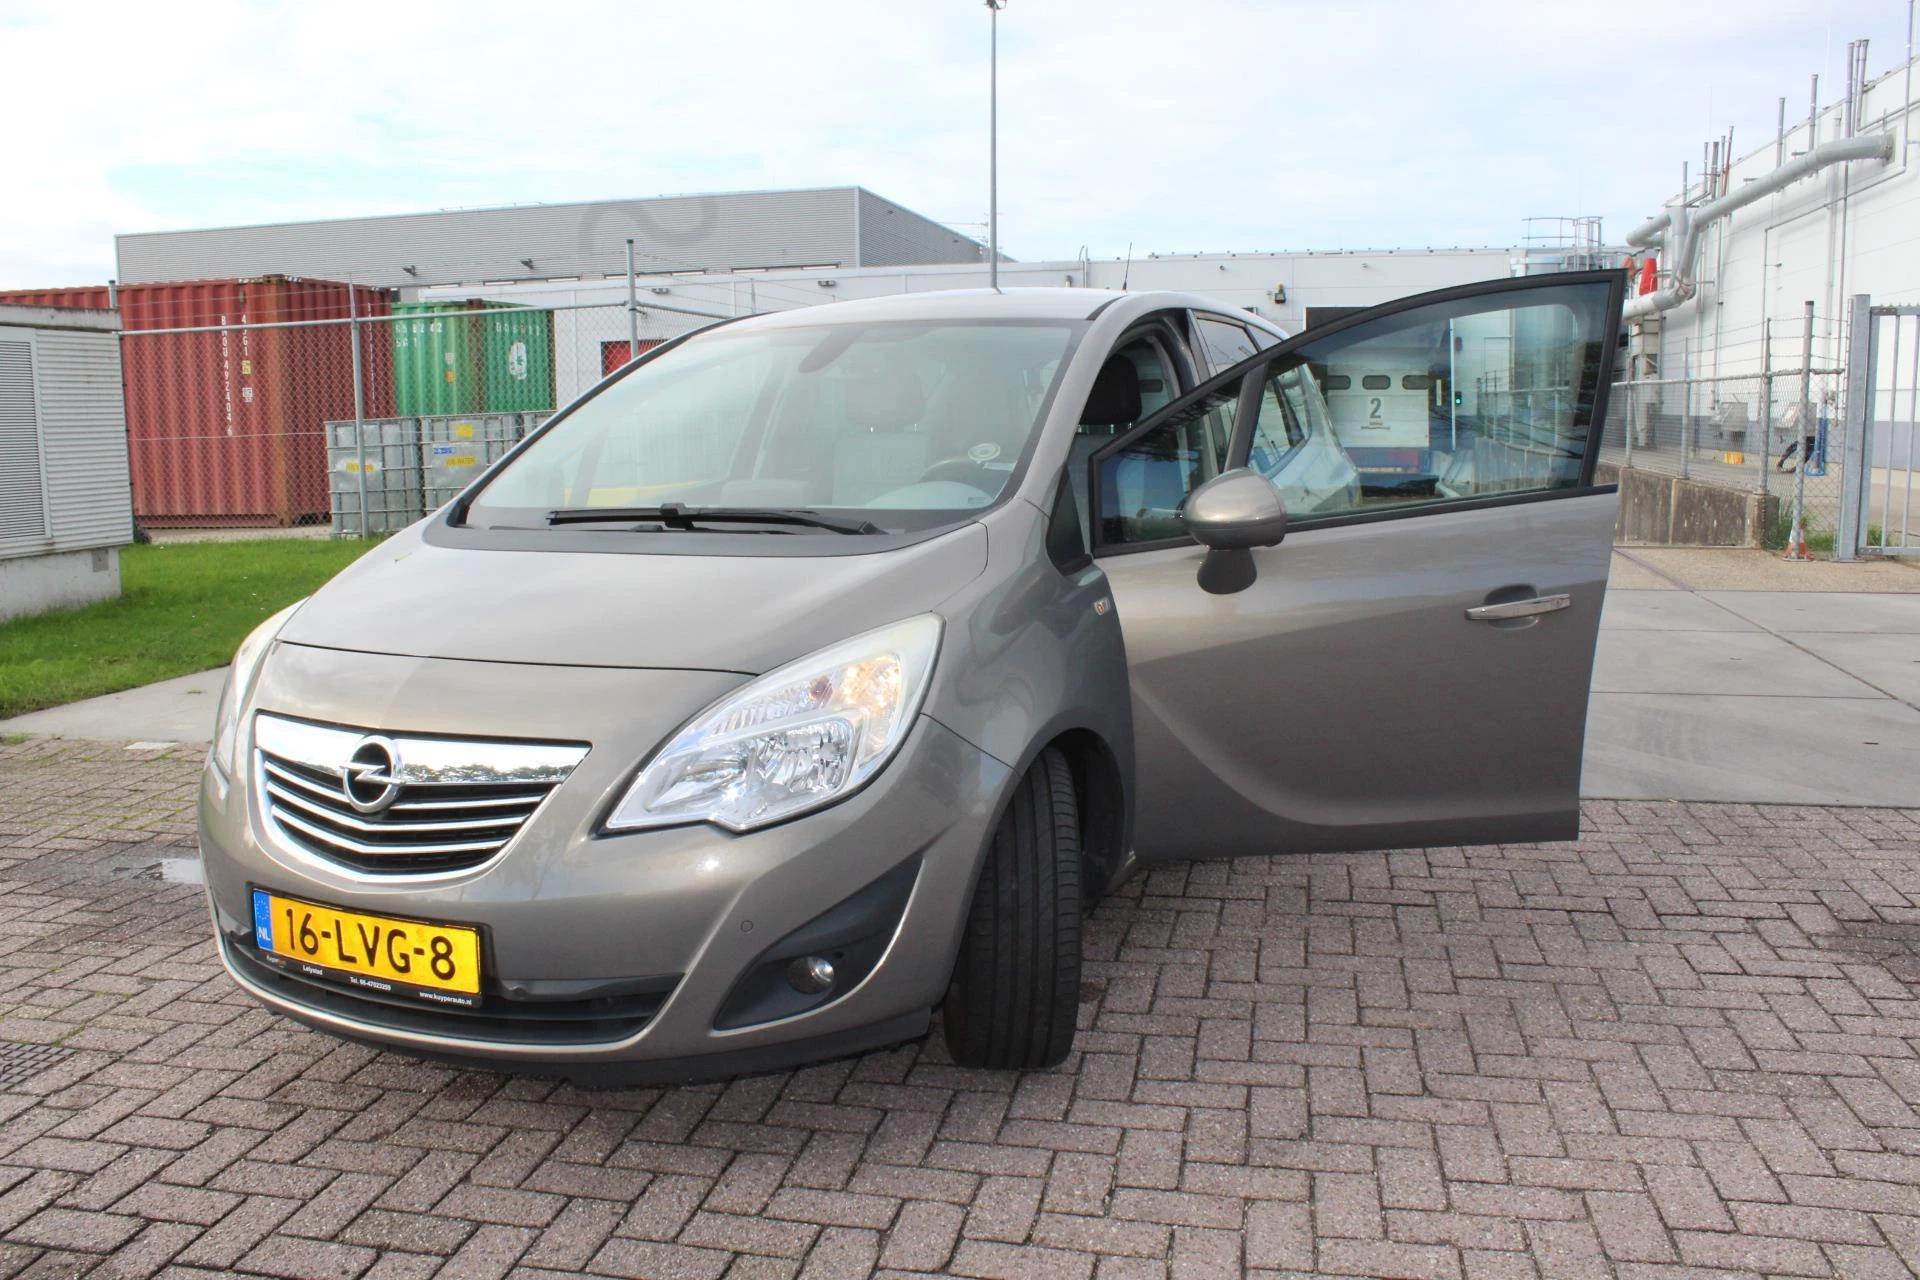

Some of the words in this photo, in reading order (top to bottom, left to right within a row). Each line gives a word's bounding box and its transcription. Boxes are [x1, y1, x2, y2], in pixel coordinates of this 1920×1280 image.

[1370, 397, 1382, 419] 2
[257, 926, 271, 941] NL
[286, 908, 456, 981] 16-LVG-8
[303, 964, 323, 976] Lelystad
